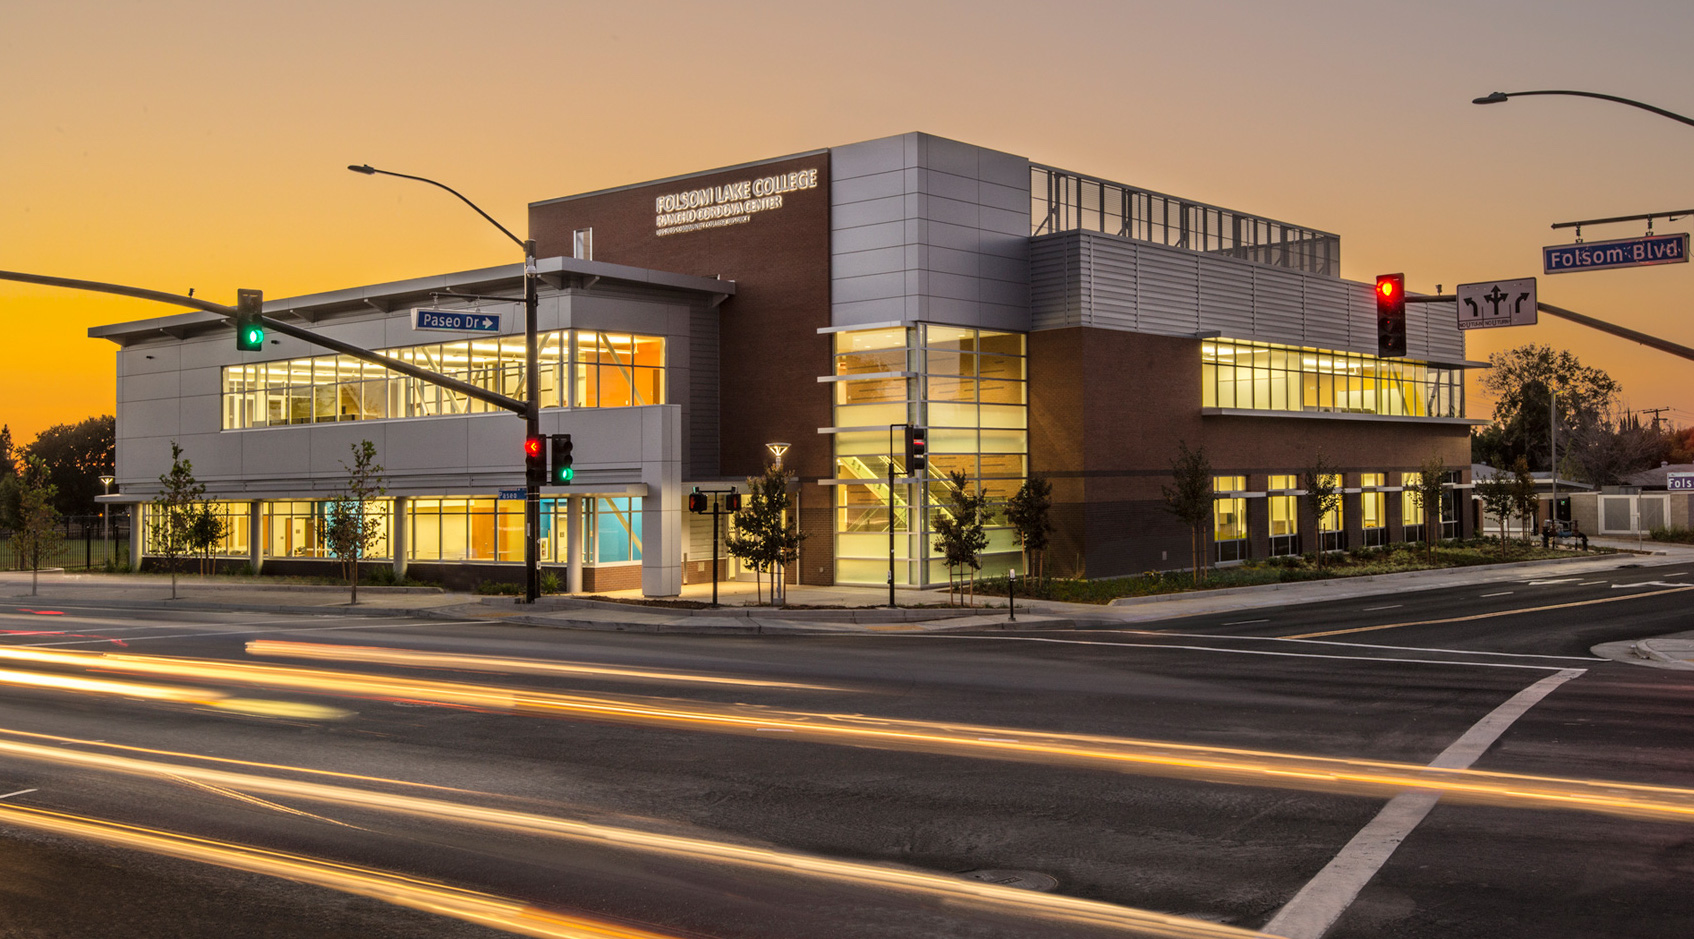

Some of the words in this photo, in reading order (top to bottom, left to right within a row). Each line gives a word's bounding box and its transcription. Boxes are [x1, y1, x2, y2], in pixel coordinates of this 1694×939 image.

[656, 187, 714, 214] FOLSOM
[715, 181, 750, 203] LAKE
[752, 169, 817, 196] COLLEGE
[656, 209, 696, 227] RANCHO
[696, 202, 743, 221] CORDOVA
[743, 195, 782, 213] CENTER
[1551, 247, 1623, 268] Folsom
[1633, 239, 1678, 261] Blvd
[424, 313, 461, 328] Paseo
[465, 316, 479, 329] Dr
[1669, 478, 1694, 488] Fols
